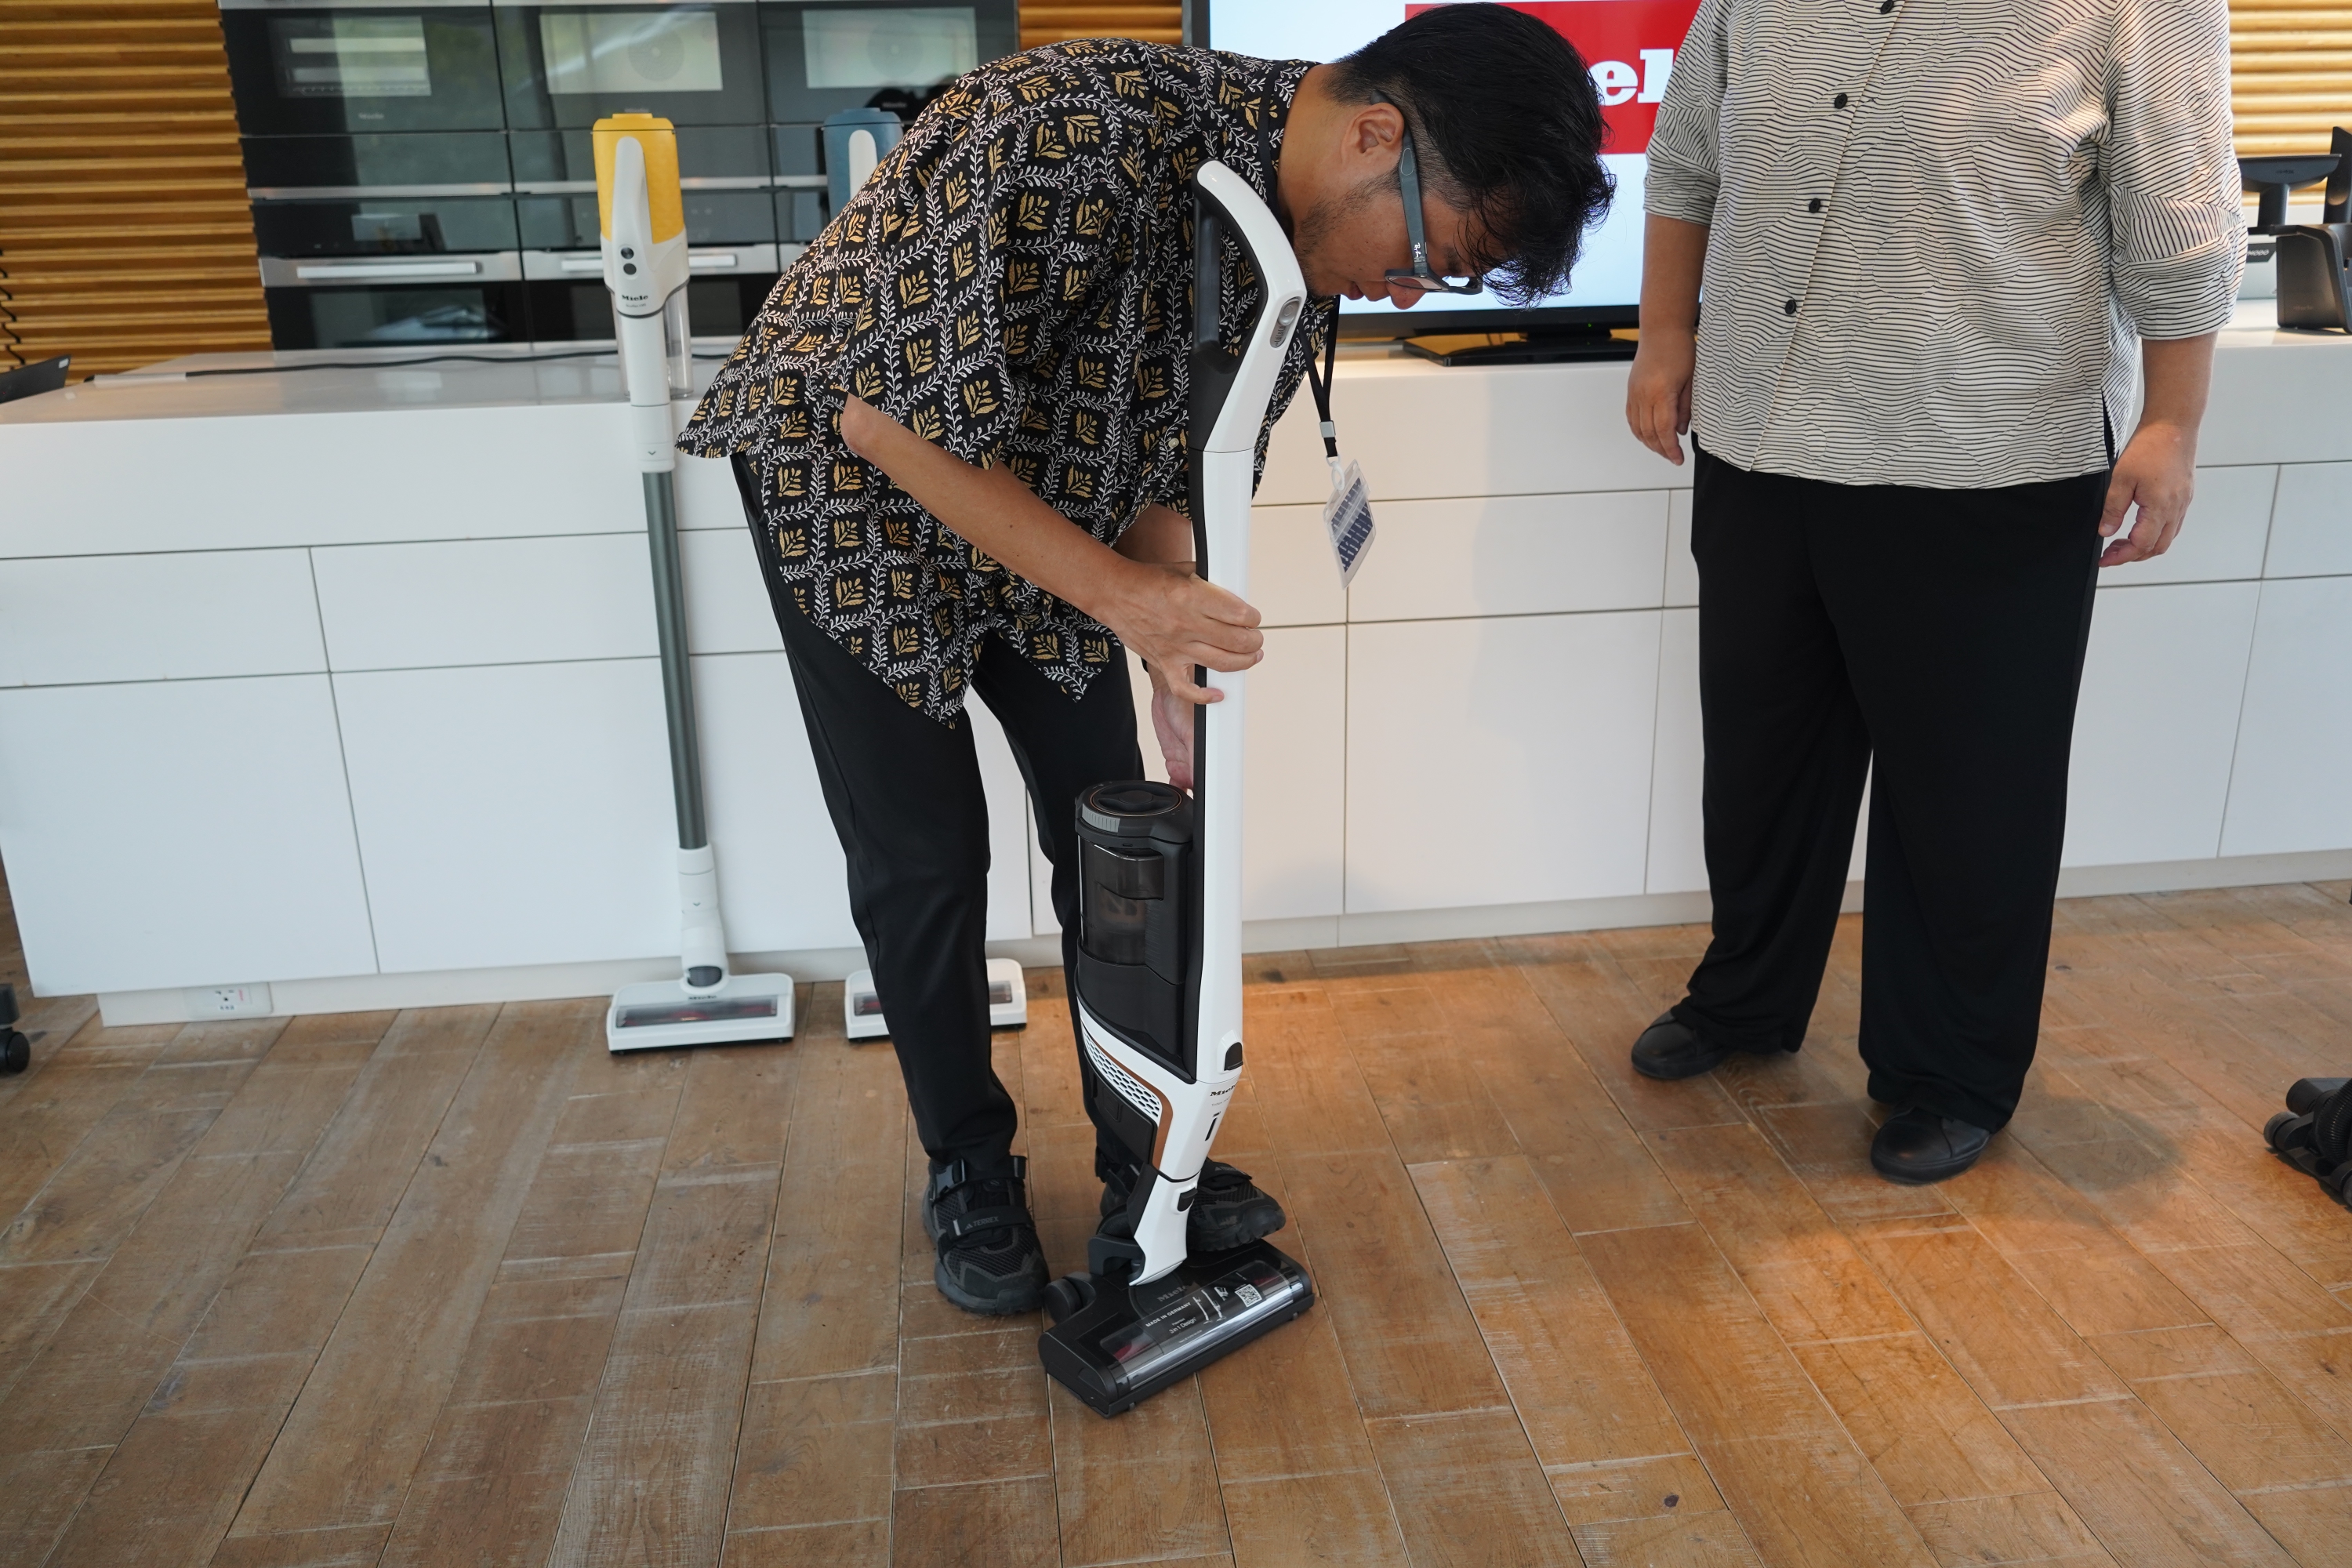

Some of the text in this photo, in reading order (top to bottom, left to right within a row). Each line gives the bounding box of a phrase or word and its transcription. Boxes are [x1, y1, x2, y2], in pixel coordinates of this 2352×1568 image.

[1587, 49, 1674, 106] el
[973, 1216, 1000, 1227] TERREX
[1145, 1318, 1161, 1327] MADE
[1167, 1301, 1191, 1316] GERMANY
